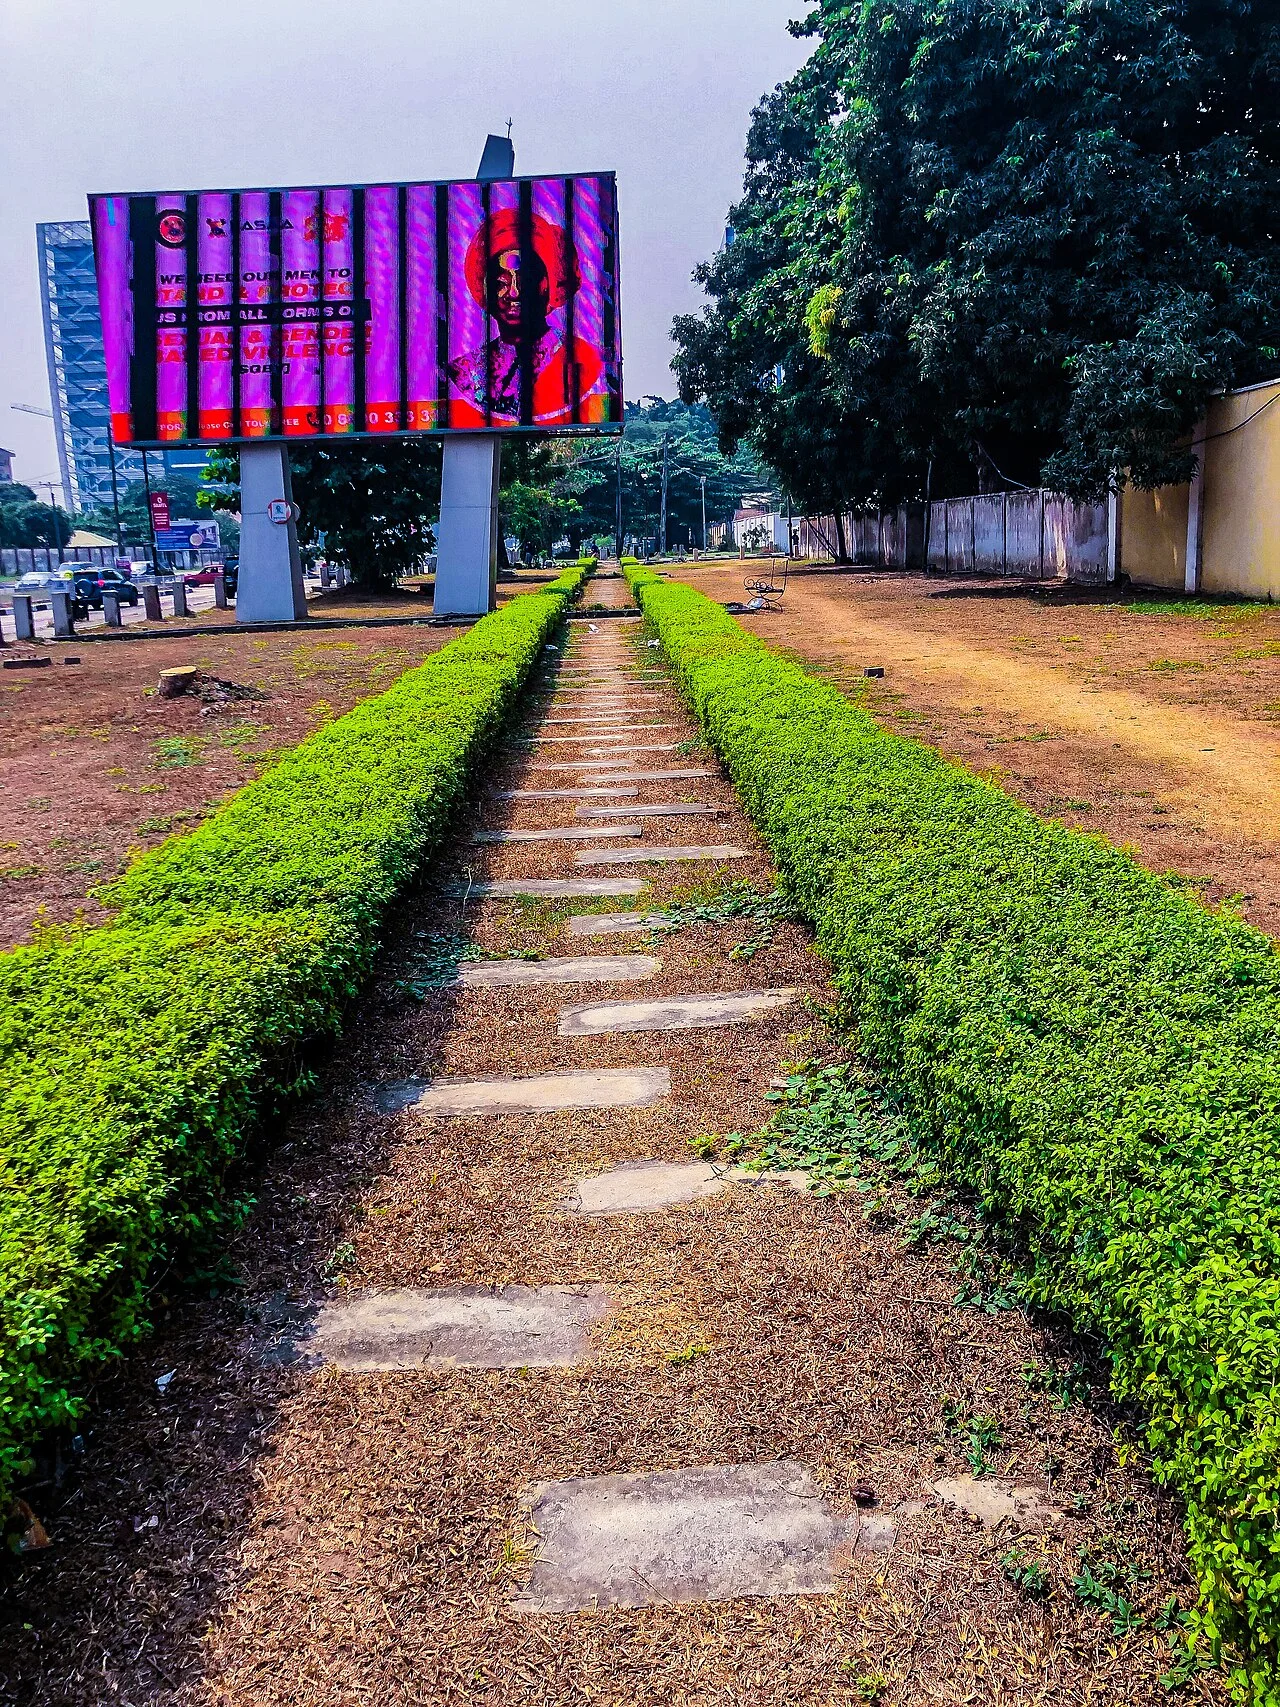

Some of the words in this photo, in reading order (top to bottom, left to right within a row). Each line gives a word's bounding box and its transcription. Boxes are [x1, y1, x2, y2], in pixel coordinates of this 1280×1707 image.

[160, 274, 185, 284] WE
[328, 268, 351, 278] TO
[275, 306, 334, 318] ORMS
[247, 329, 263, 343] &
